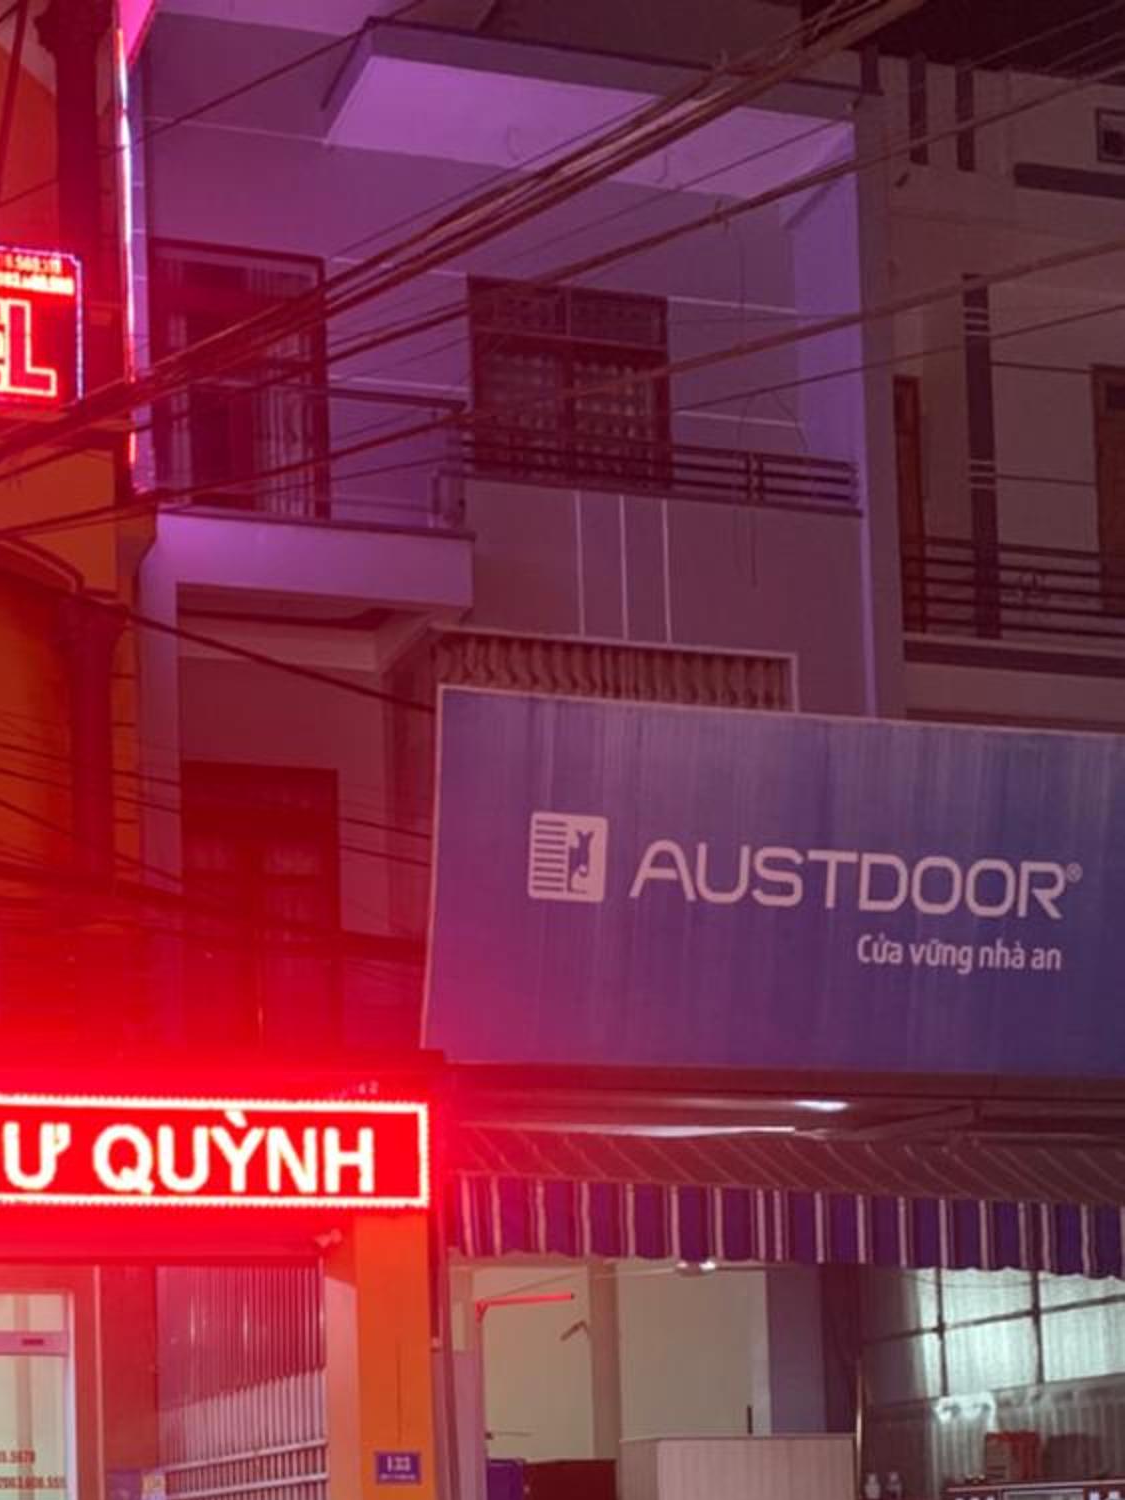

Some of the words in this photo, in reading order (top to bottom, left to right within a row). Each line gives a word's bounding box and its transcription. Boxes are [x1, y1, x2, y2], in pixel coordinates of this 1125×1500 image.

[856, 932, 903, 966] Cửa
[910, 937, 973, 974] vững
[978, 937, 1026, 970] nhà
[1030, 945, 1063, 971] an
[91, 1110, 375, 1197] QUỲNH
